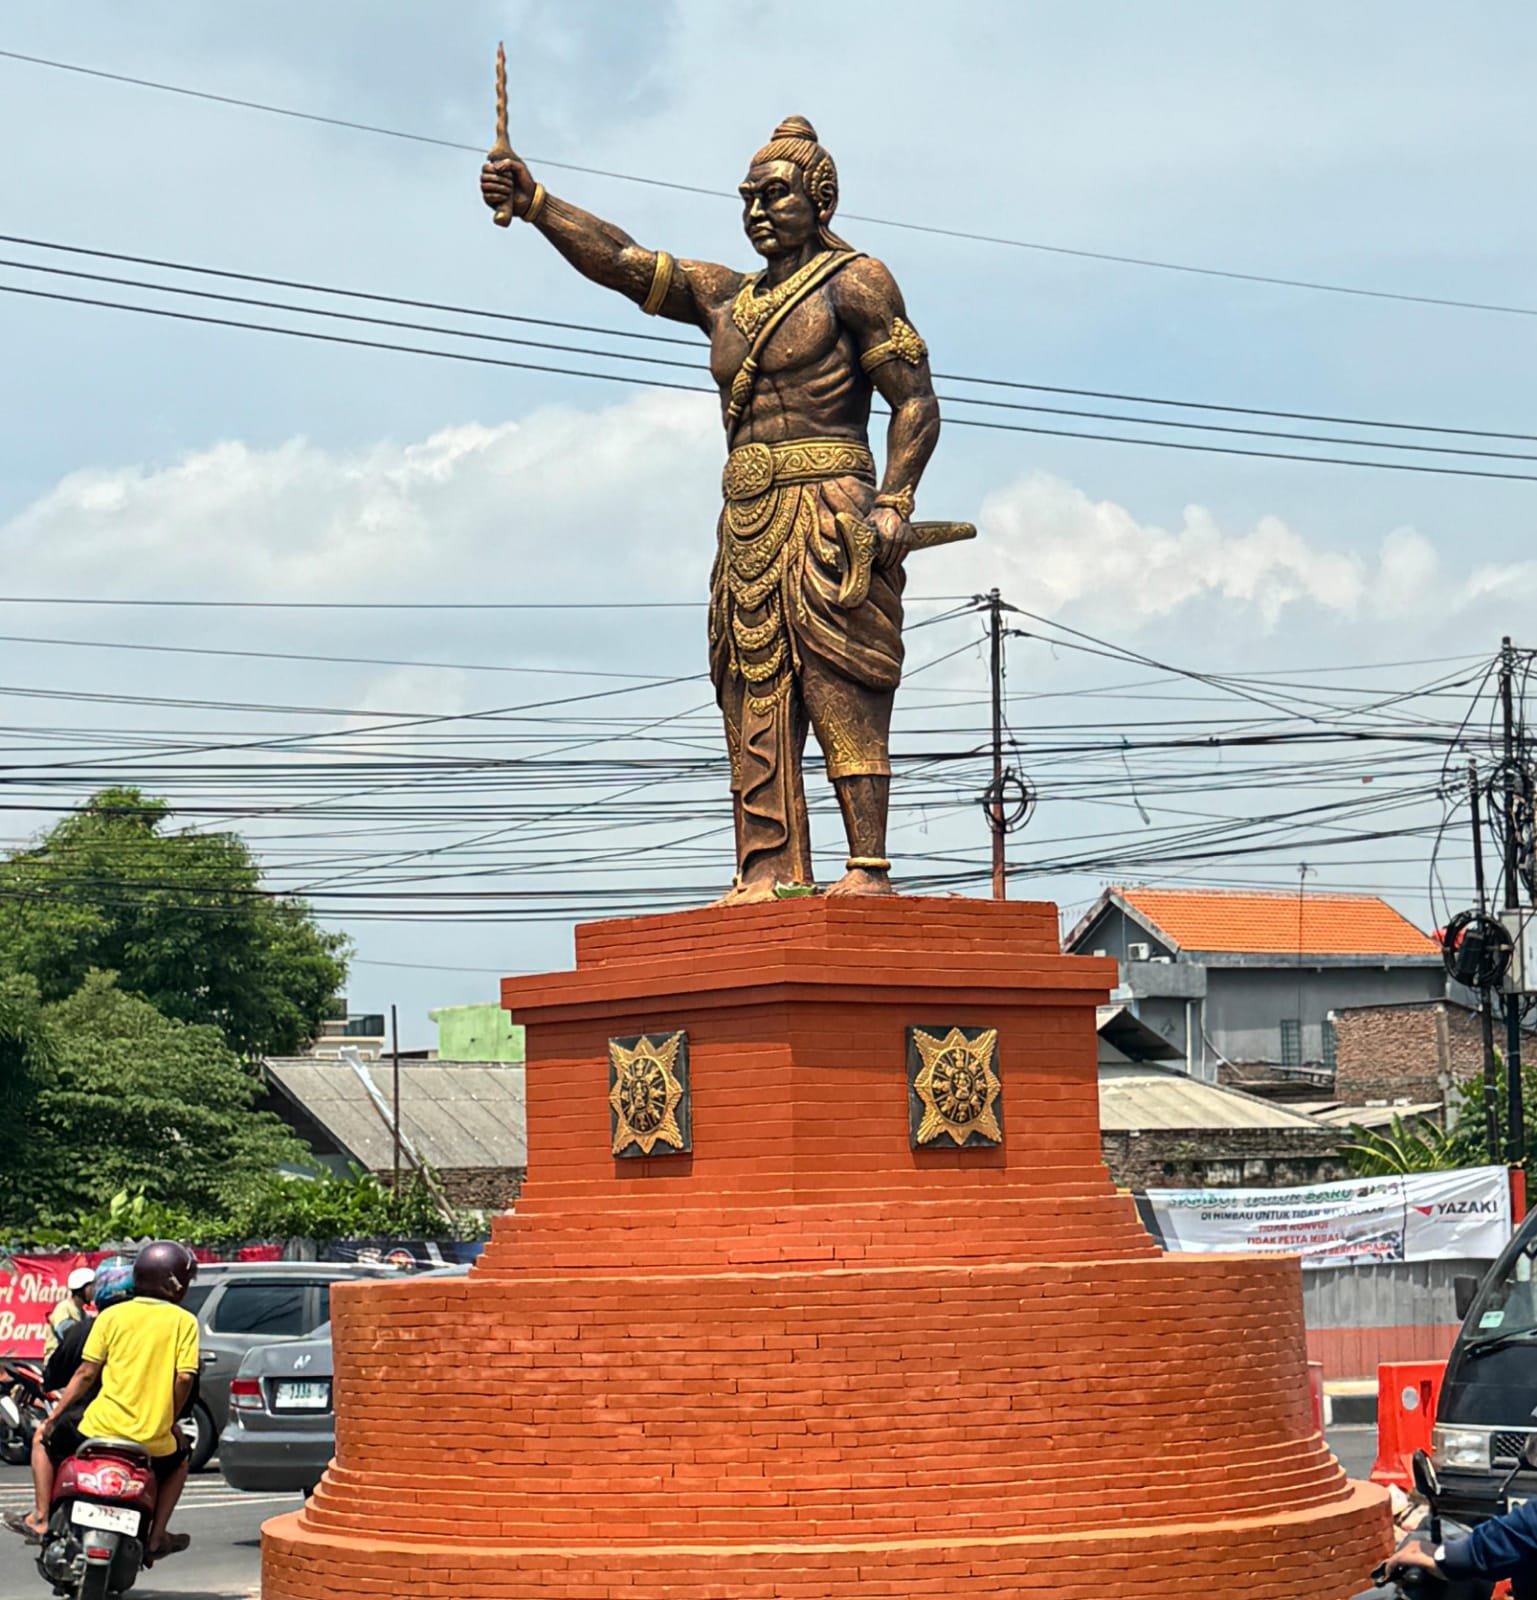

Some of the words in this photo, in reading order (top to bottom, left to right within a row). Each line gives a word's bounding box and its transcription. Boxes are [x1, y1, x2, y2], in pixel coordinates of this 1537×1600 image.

[1437, 1200, 1498, 1215] YAZAKI
[1201, 1212, 1212, 1221] DI
[1213, 1211, 1254, 1220] HIMBAU
[1255, 1210, 1290, 1220] UNTUK
[1292, 1209, 1321, 1219] TIDAK
[1247, 1236, 1276, 1245] TIDAK
[1278, 1234, 1309, 1245] PESTA
[0, 1310, 48, 1341] Baru
